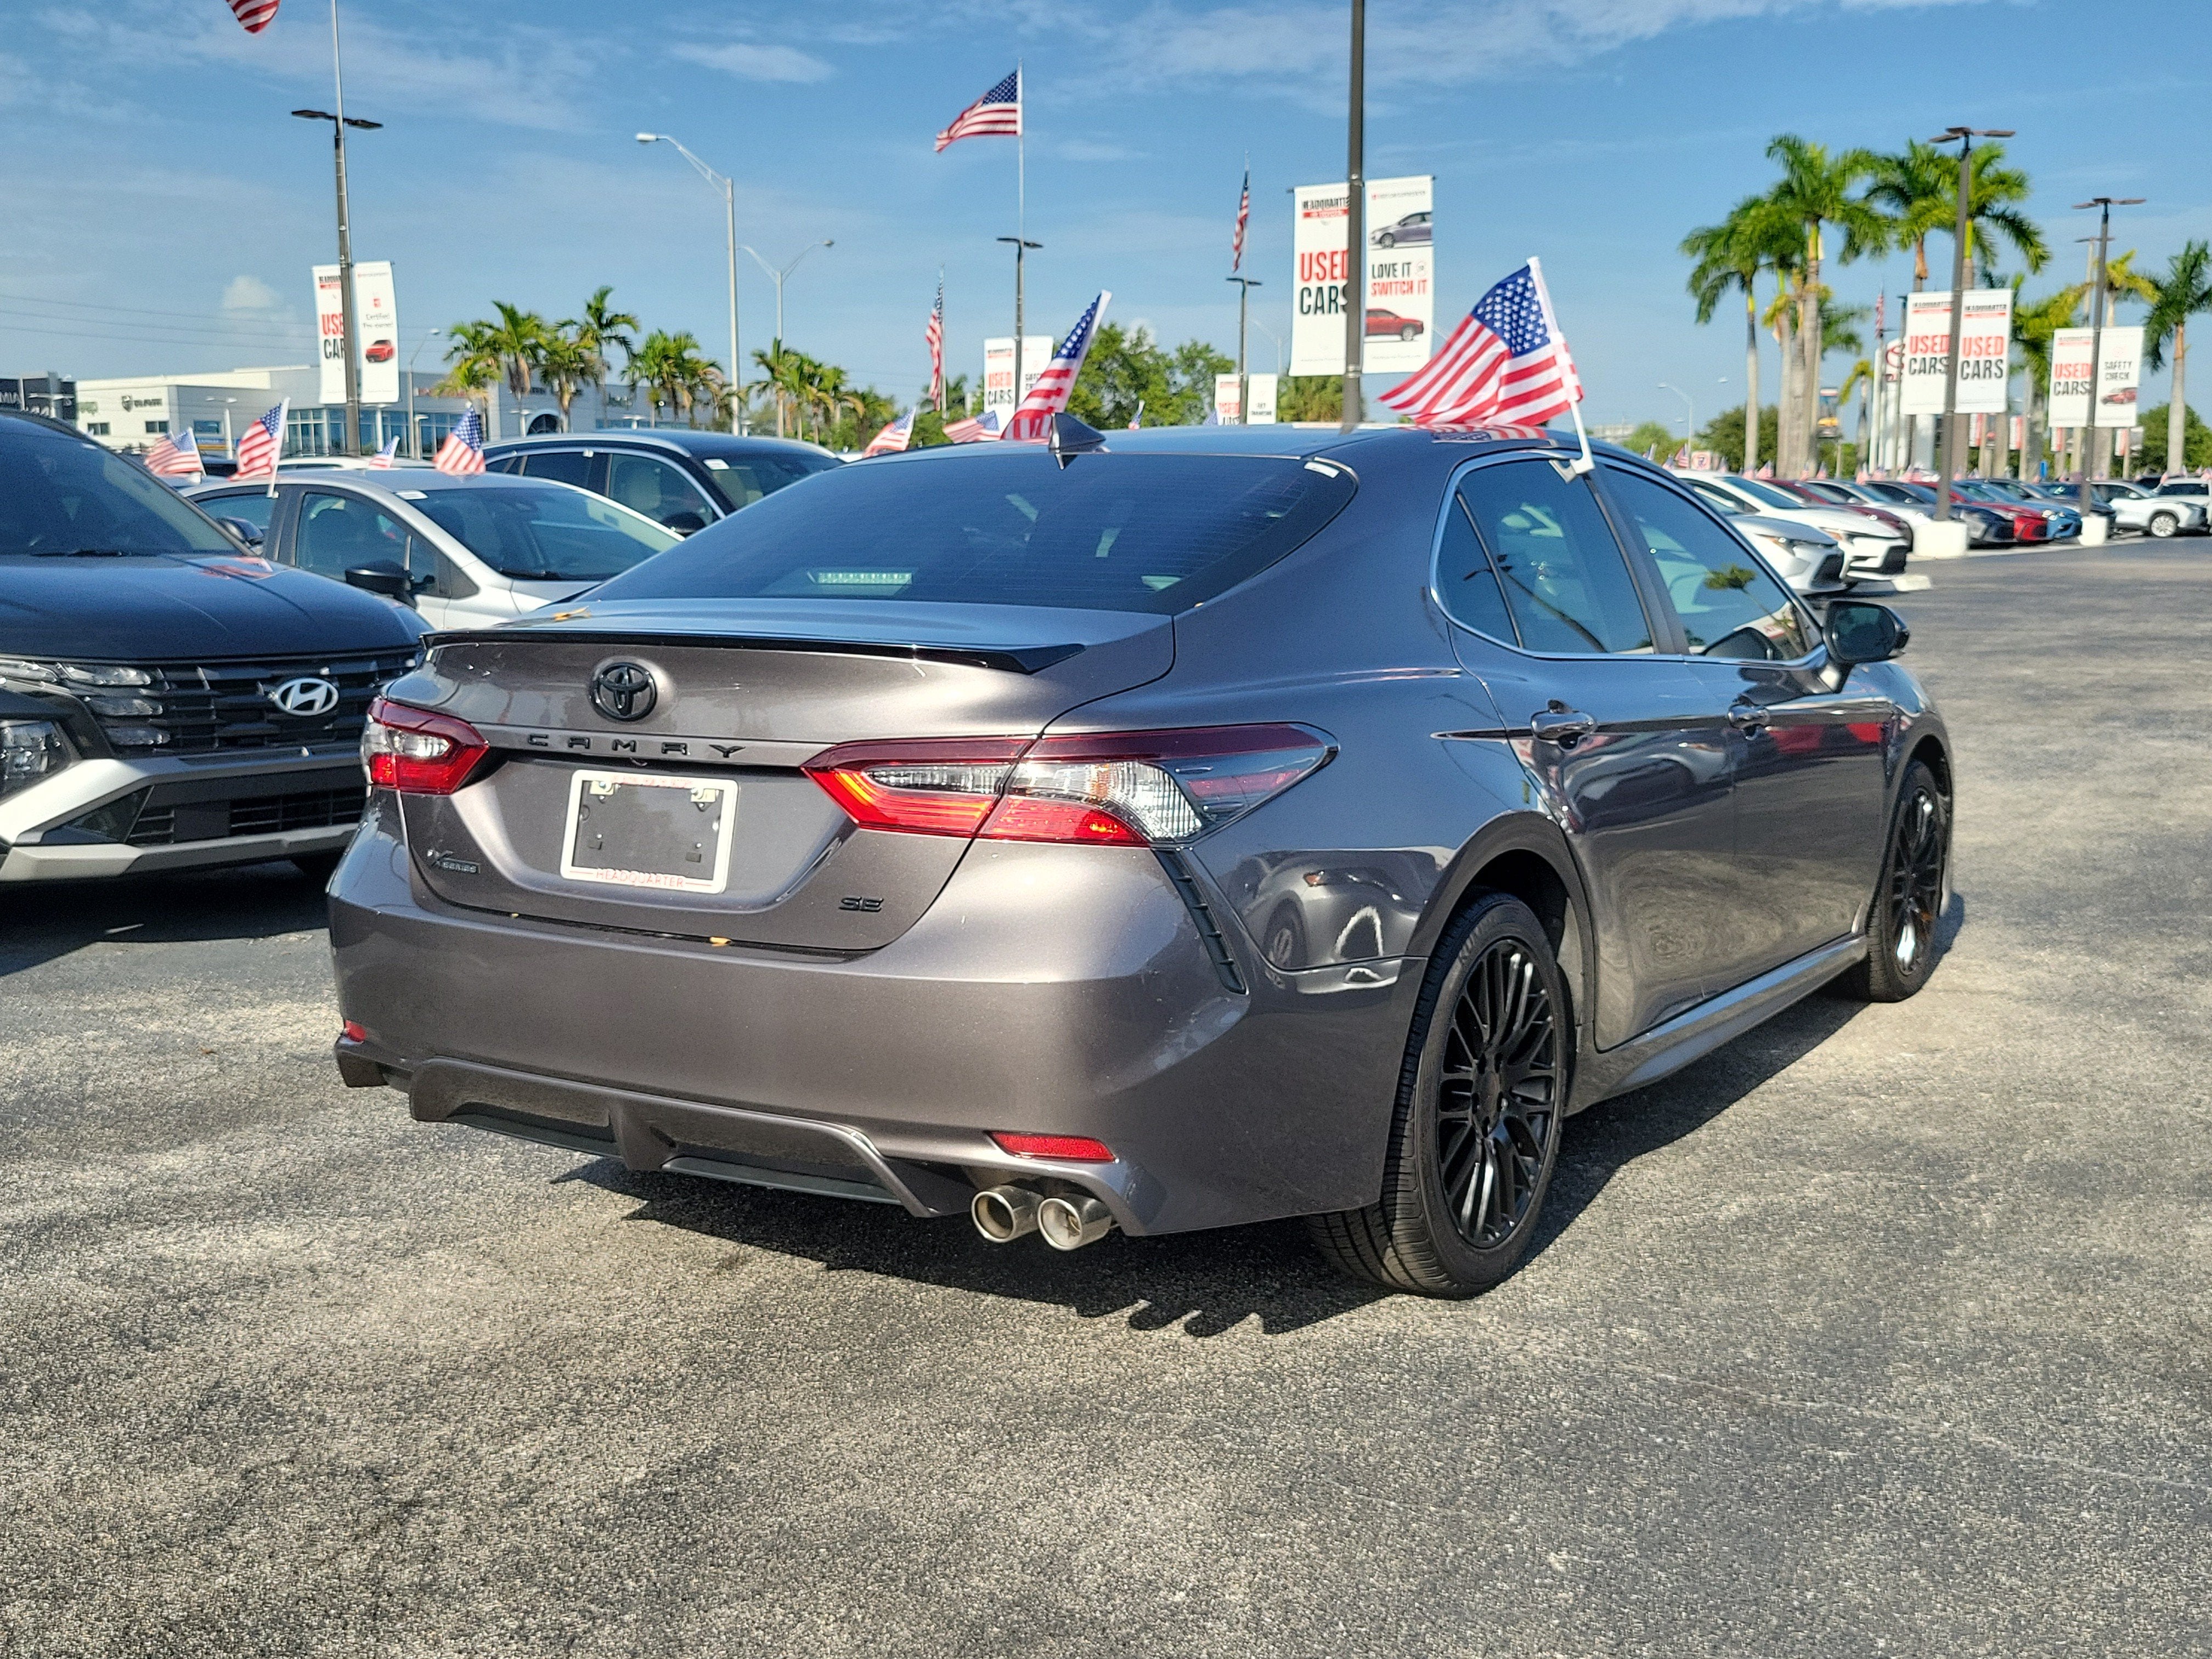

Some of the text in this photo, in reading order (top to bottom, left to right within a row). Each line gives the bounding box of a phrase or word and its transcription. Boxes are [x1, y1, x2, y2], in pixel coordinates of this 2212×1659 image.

[1372, 262, 1412, 279] LOVE IT
[1372, 279, 1426, 296] SWITCH IT
[321, 313, 344, 336] USE
[1909, 335, 1950, 354] USED
[1963, 336, 2004, 357] USED
[1909, 357, 1949, 375] CARS
[1961, 359, 2004, 380] CARS
[2055, 363, 2092, 380] USED
[2104, 360, 2132, 370] SAFETY
[2053, 381, 2092, 396] CARS
[527, 733, 746, 758] CAMRY
[596, 869, 685, 888] HEADQUARTER
[838, 896, 884, 913] SE
